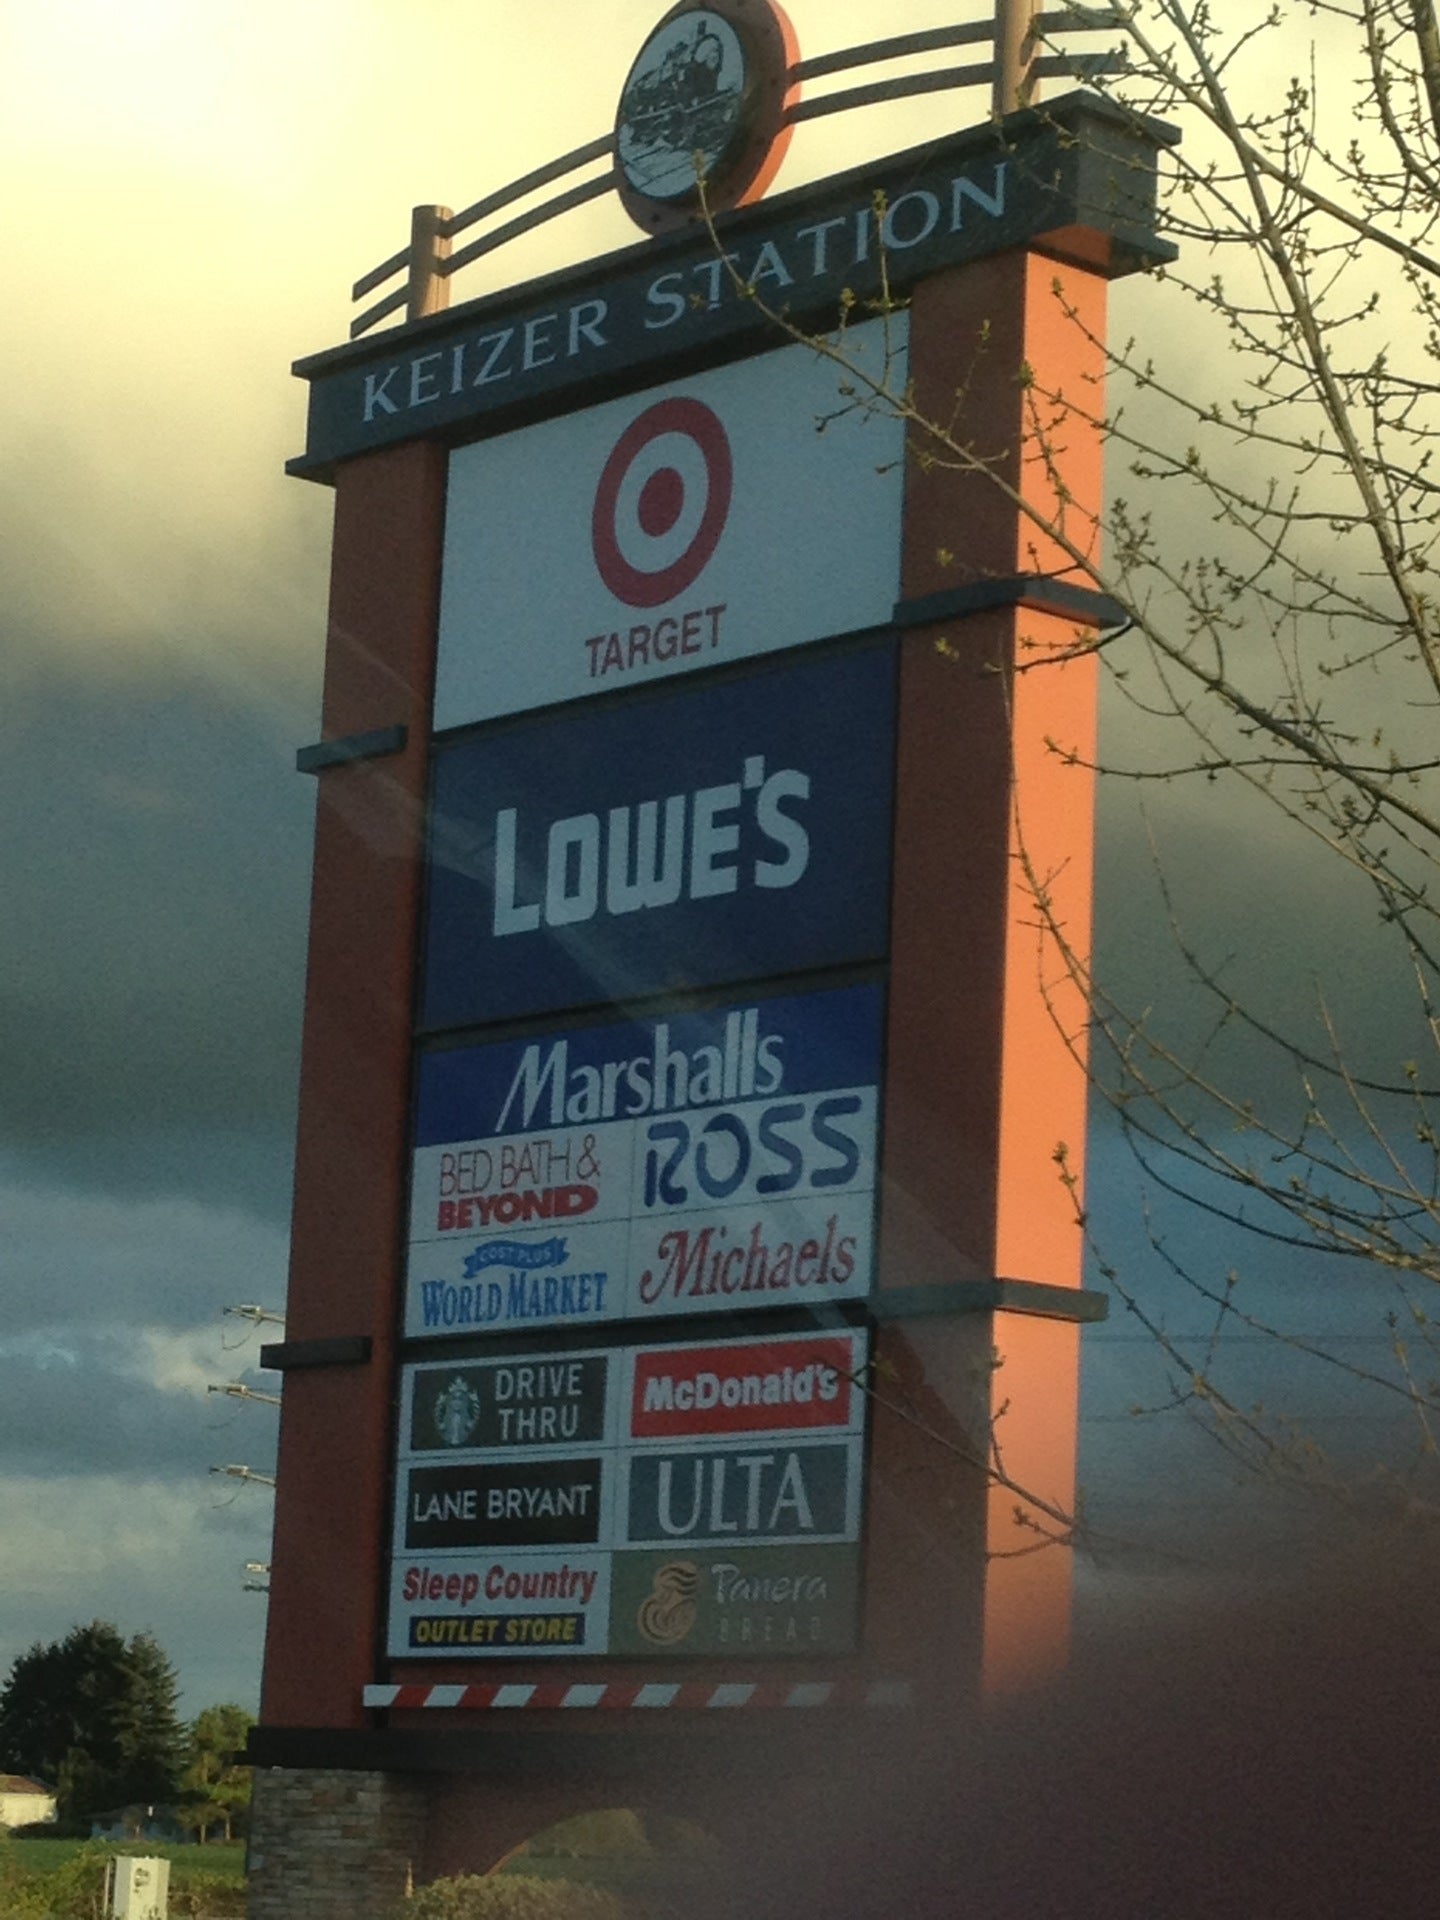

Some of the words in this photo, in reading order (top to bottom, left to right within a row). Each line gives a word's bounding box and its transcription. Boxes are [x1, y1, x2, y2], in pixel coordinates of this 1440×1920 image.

[363, 301, 609, 422] KEIZER
[644, 163, 1008, 331] STATION
[585, 604, 727, 678] TARGET
[494, 755, 811, 937] LOWE'S
[495, 1008, 784, 1132] Marshalls
[439, 1148, 493, 1196] BED
[501, 1138, 571, 1189] BATH
[576, 1133, 600, 1181] &
[644, 1095, 863, 1207] ROSS
[437, 1184, 599, 1231] BEYOND
[639, 1214, 857, 1304] Michaels
[422, 1278, 501, 1327] WORLD
[505, 1271, 607, 1320] MARKET
[495, 1363, 583, 1402] DRIVE
[643, 1363, 839, 1413] McDonald's
[498, 1406, 578, 1441] THRU
[413, 1489, 477, 1522] LANE
[487, 1484, 593, 1520] BRYANT
[658, 1453, 814, 1535] ULTA
[403, 1566, 478, 1606] Sleep
[485, 1564, 596, 1604] Country
[710, 1562, 828, 1605] Panera
[415, 1618, 500, 1643] OUTLET
[504, 1616, 577, 1641] STORE
